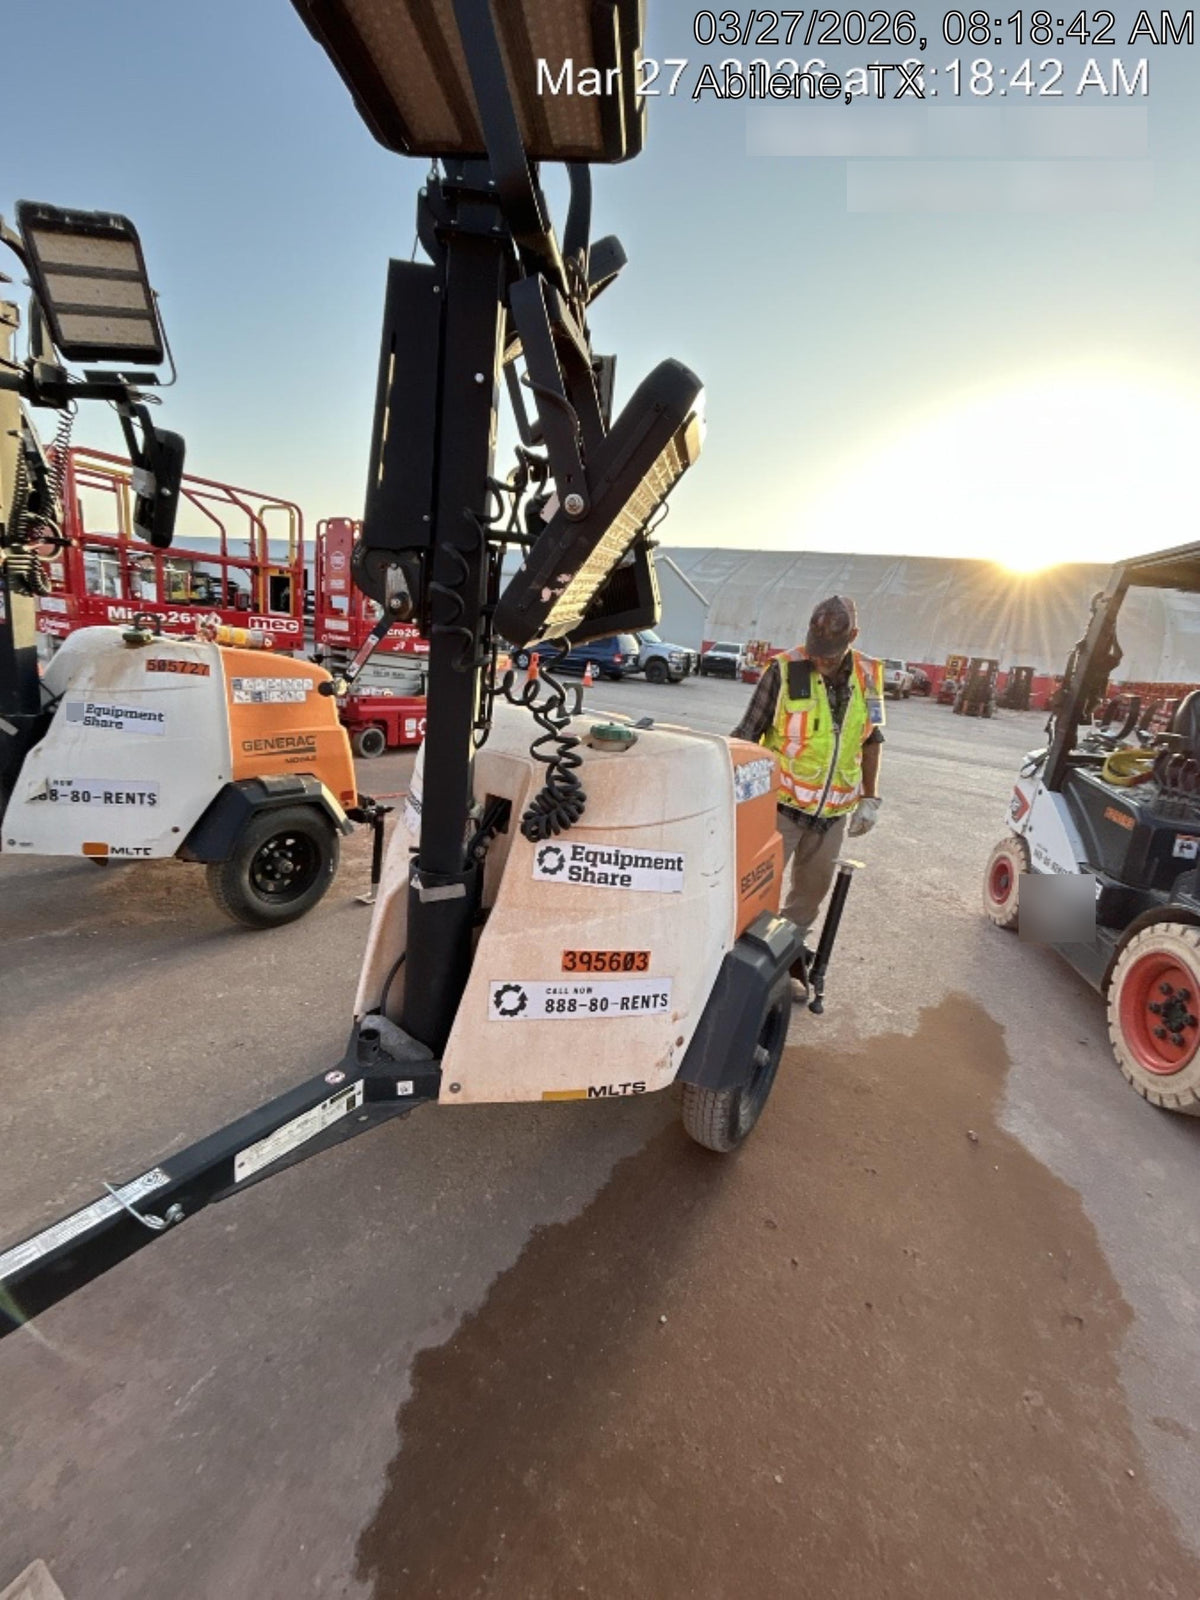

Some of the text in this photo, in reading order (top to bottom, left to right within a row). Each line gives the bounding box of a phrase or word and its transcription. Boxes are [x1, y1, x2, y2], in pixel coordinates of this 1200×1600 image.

[248, 617, 299, 633] mec
[146, 660, 209, 675] 505727
[85, 704, 164, 722] Equipment
[83, 716, 123, 729] Share
[242, 735, 317, 752] GENERAC
[30, 789, 157, 806] 88-80-RENTS
[570, 844, 683, 871] Equipment
[568, 865, 632, 887] Share
[563, 951, 648, 971] 395603
[545, 994, 668, 1012] 888-80-RENTS
[588, 1082, 646, 1098] MLTS
